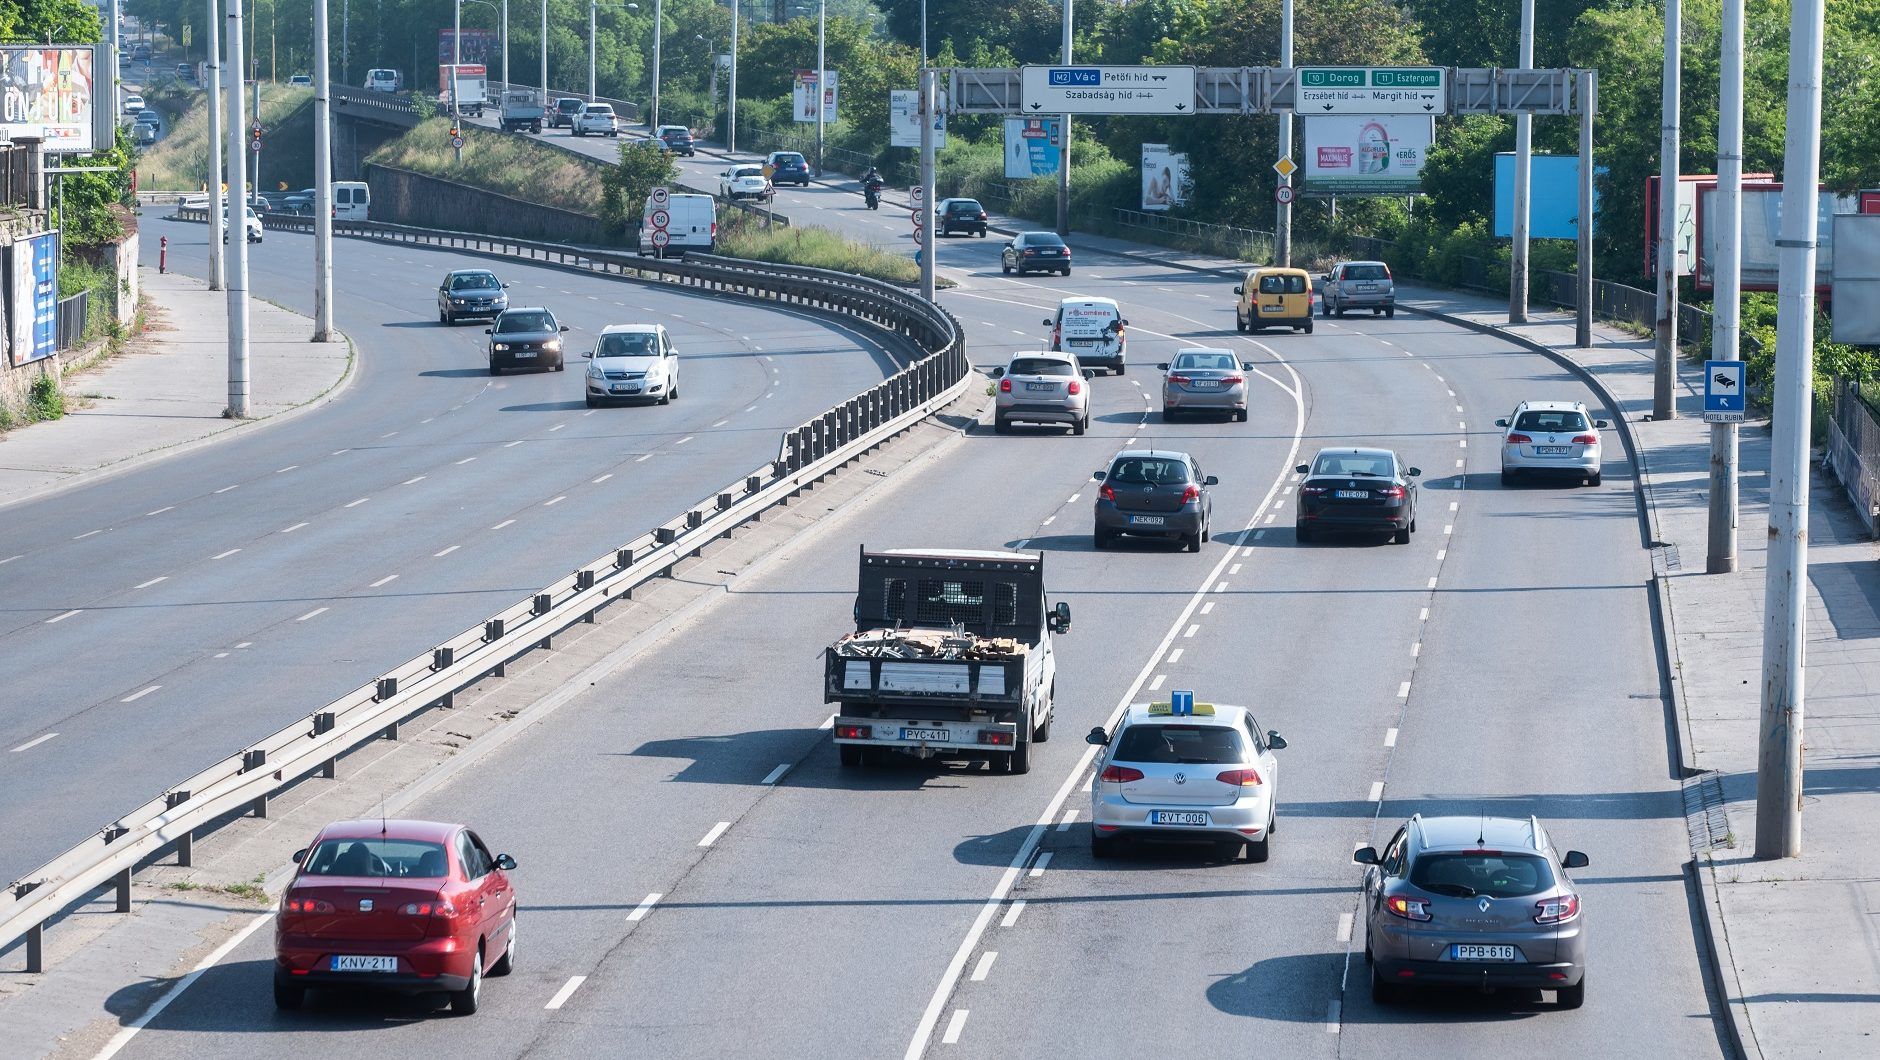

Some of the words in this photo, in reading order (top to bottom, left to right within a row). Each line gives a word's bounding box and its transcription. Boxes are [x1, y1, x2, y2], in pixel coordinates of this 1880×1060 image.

[1056, 73, 1068, 81] M2
[1075, 72, 1096, 81] Vác
[1312, 74, 1320, 82] 10
[1330, 73, 1359, 83] Dorog
[1382, 74, 1388, 82] 11
[1397, 73, 1436, 84] Esztergom
[1065, 90, 1115, 101] Szabadság
[1304, 91, 1335, 100] Erzsébet
[1337, 91, 1349, 100] híd
[1372, 91, 1402, 102] Margit
[1404, 91, 1418, 100] híd
[1280, 190, 1290, 198] 70
[656, 215, 666, 223] 50
[1705, 413, 1723, 421] HOTEL
[1724, 413, 1743, 421] RUBIN
[1173, 692, 1191, 713] T
[906, 729, 947, 740] PYC-411
[1159, 812, 1204, 824] RVT-006
[1459, 946, 1512, 957] PPB-616
[340, 957, 395, 968] KNV-211
